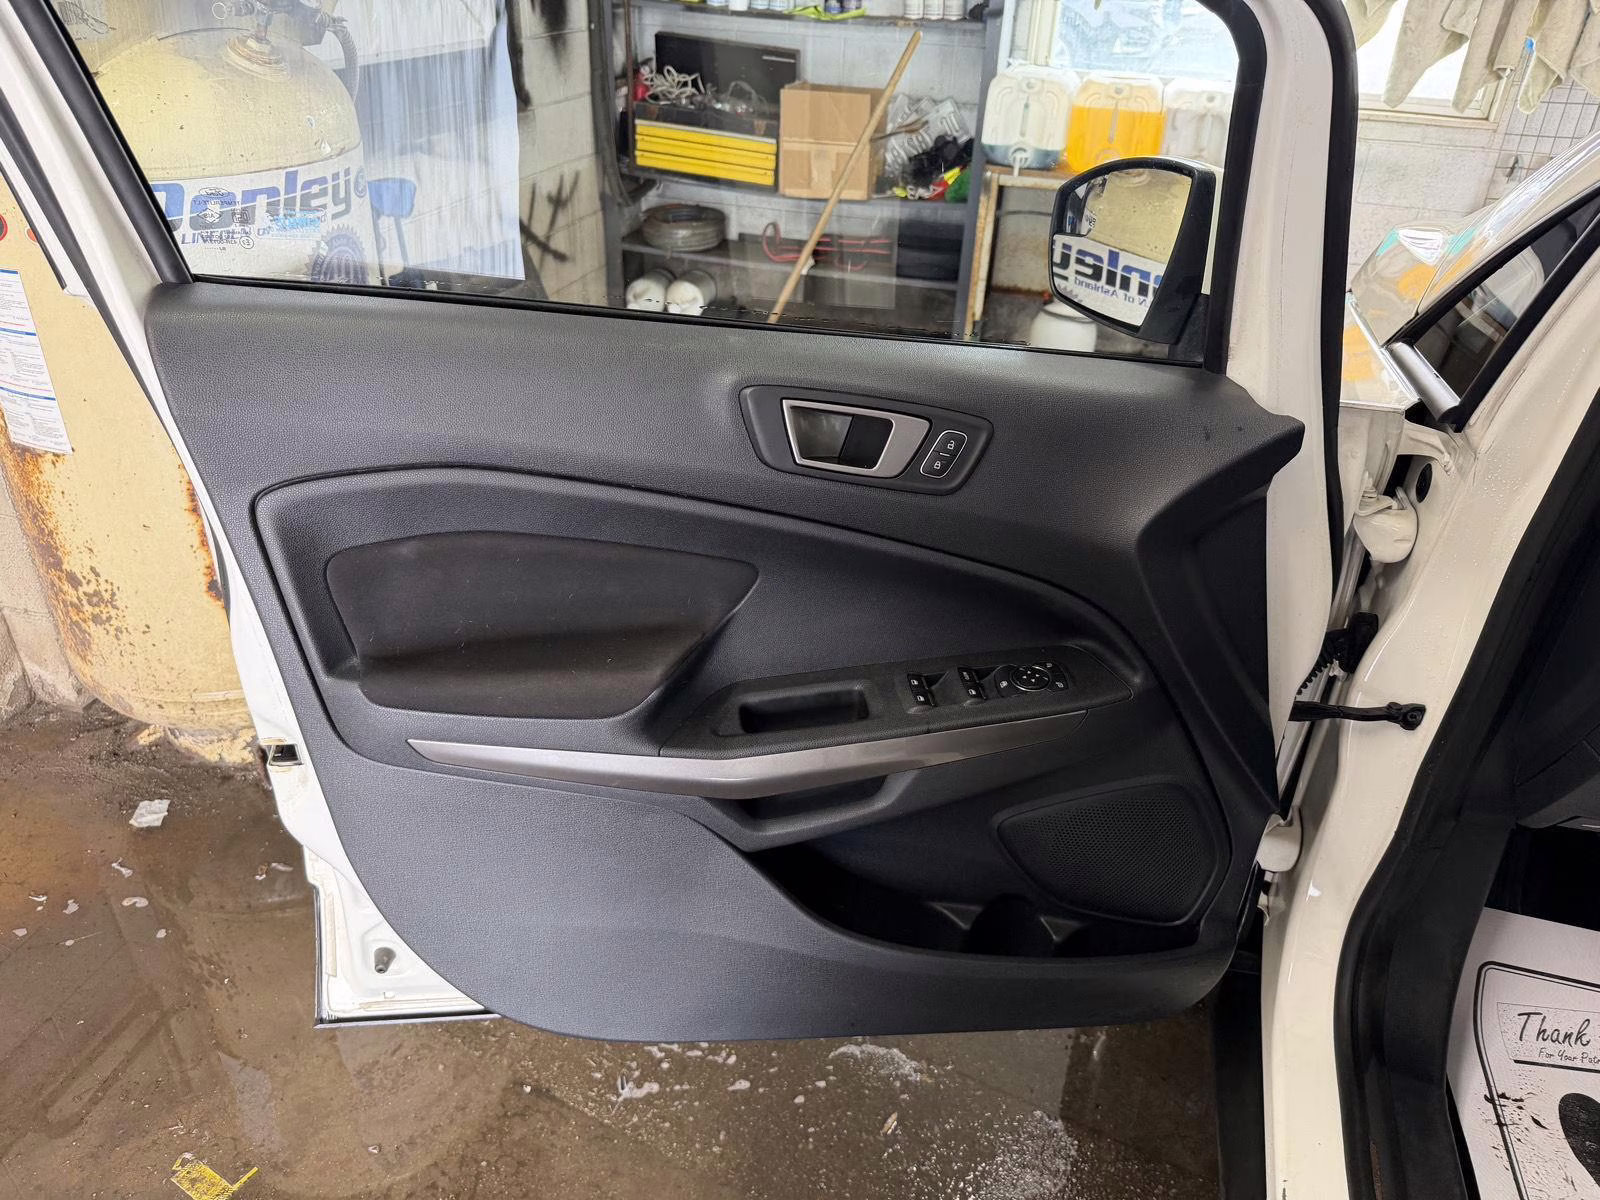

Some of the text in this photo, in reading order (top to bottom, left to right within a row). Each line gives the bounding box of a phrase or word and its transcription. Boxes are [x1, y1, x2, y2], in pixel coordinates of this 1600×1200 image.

[1517, 1012, 1591, 1047] Thank
[1538, 1047, 1554, 1059] For
[1557, 1049, 1578, 1061] Your
